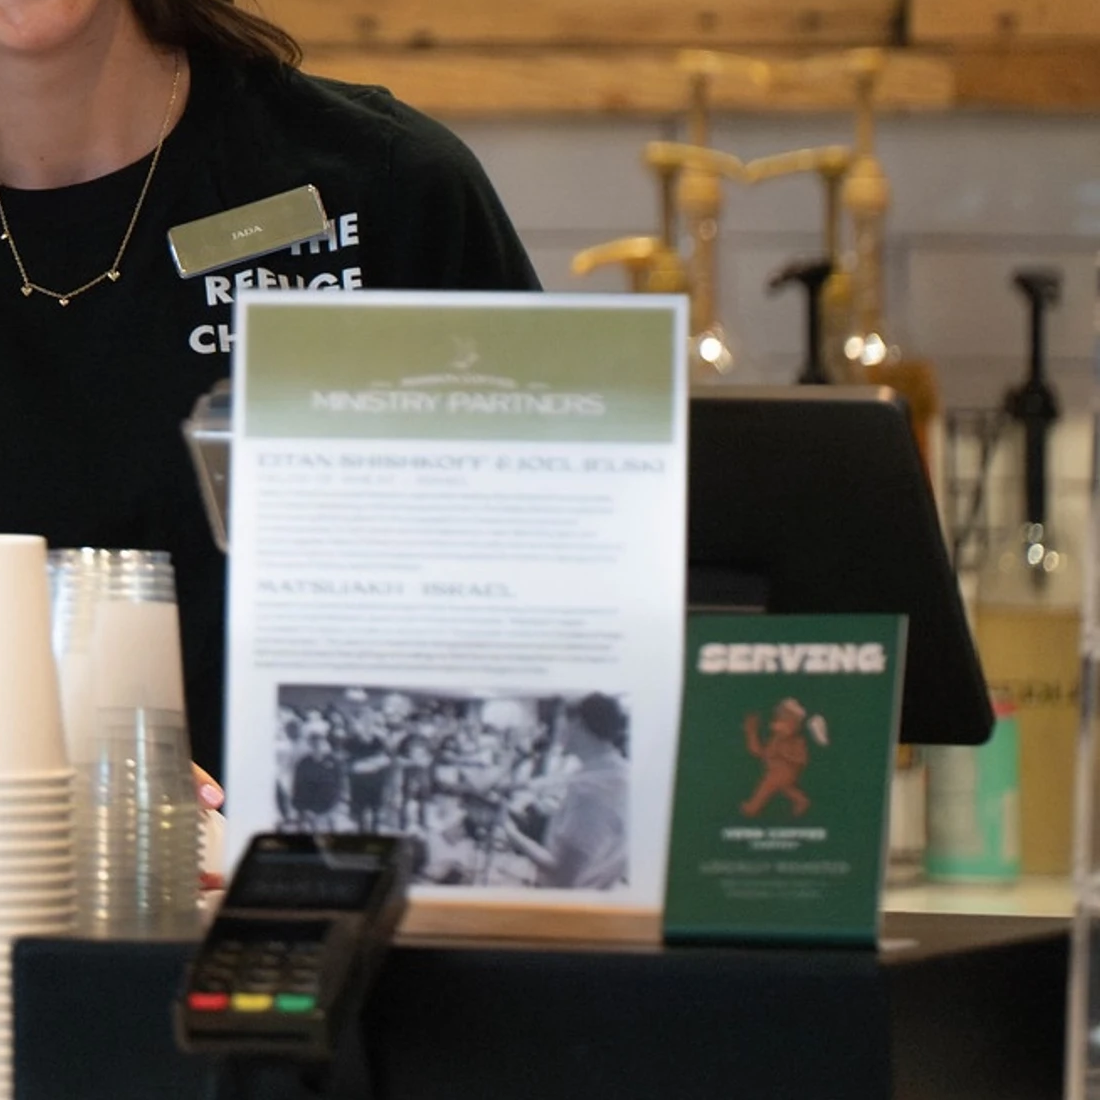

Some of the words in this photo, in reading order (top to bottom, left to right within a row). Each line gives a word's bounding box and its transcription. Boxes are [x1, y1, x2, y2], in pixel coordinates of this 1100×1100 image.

[231, 225, 263, 240] JADA
[189, 324, 236, 354] CH
[310, 390, 438, 415] MINISTRY
[449, 390, 606, 416] PARTNERS
[697, 643, 886, 673] SERVING
